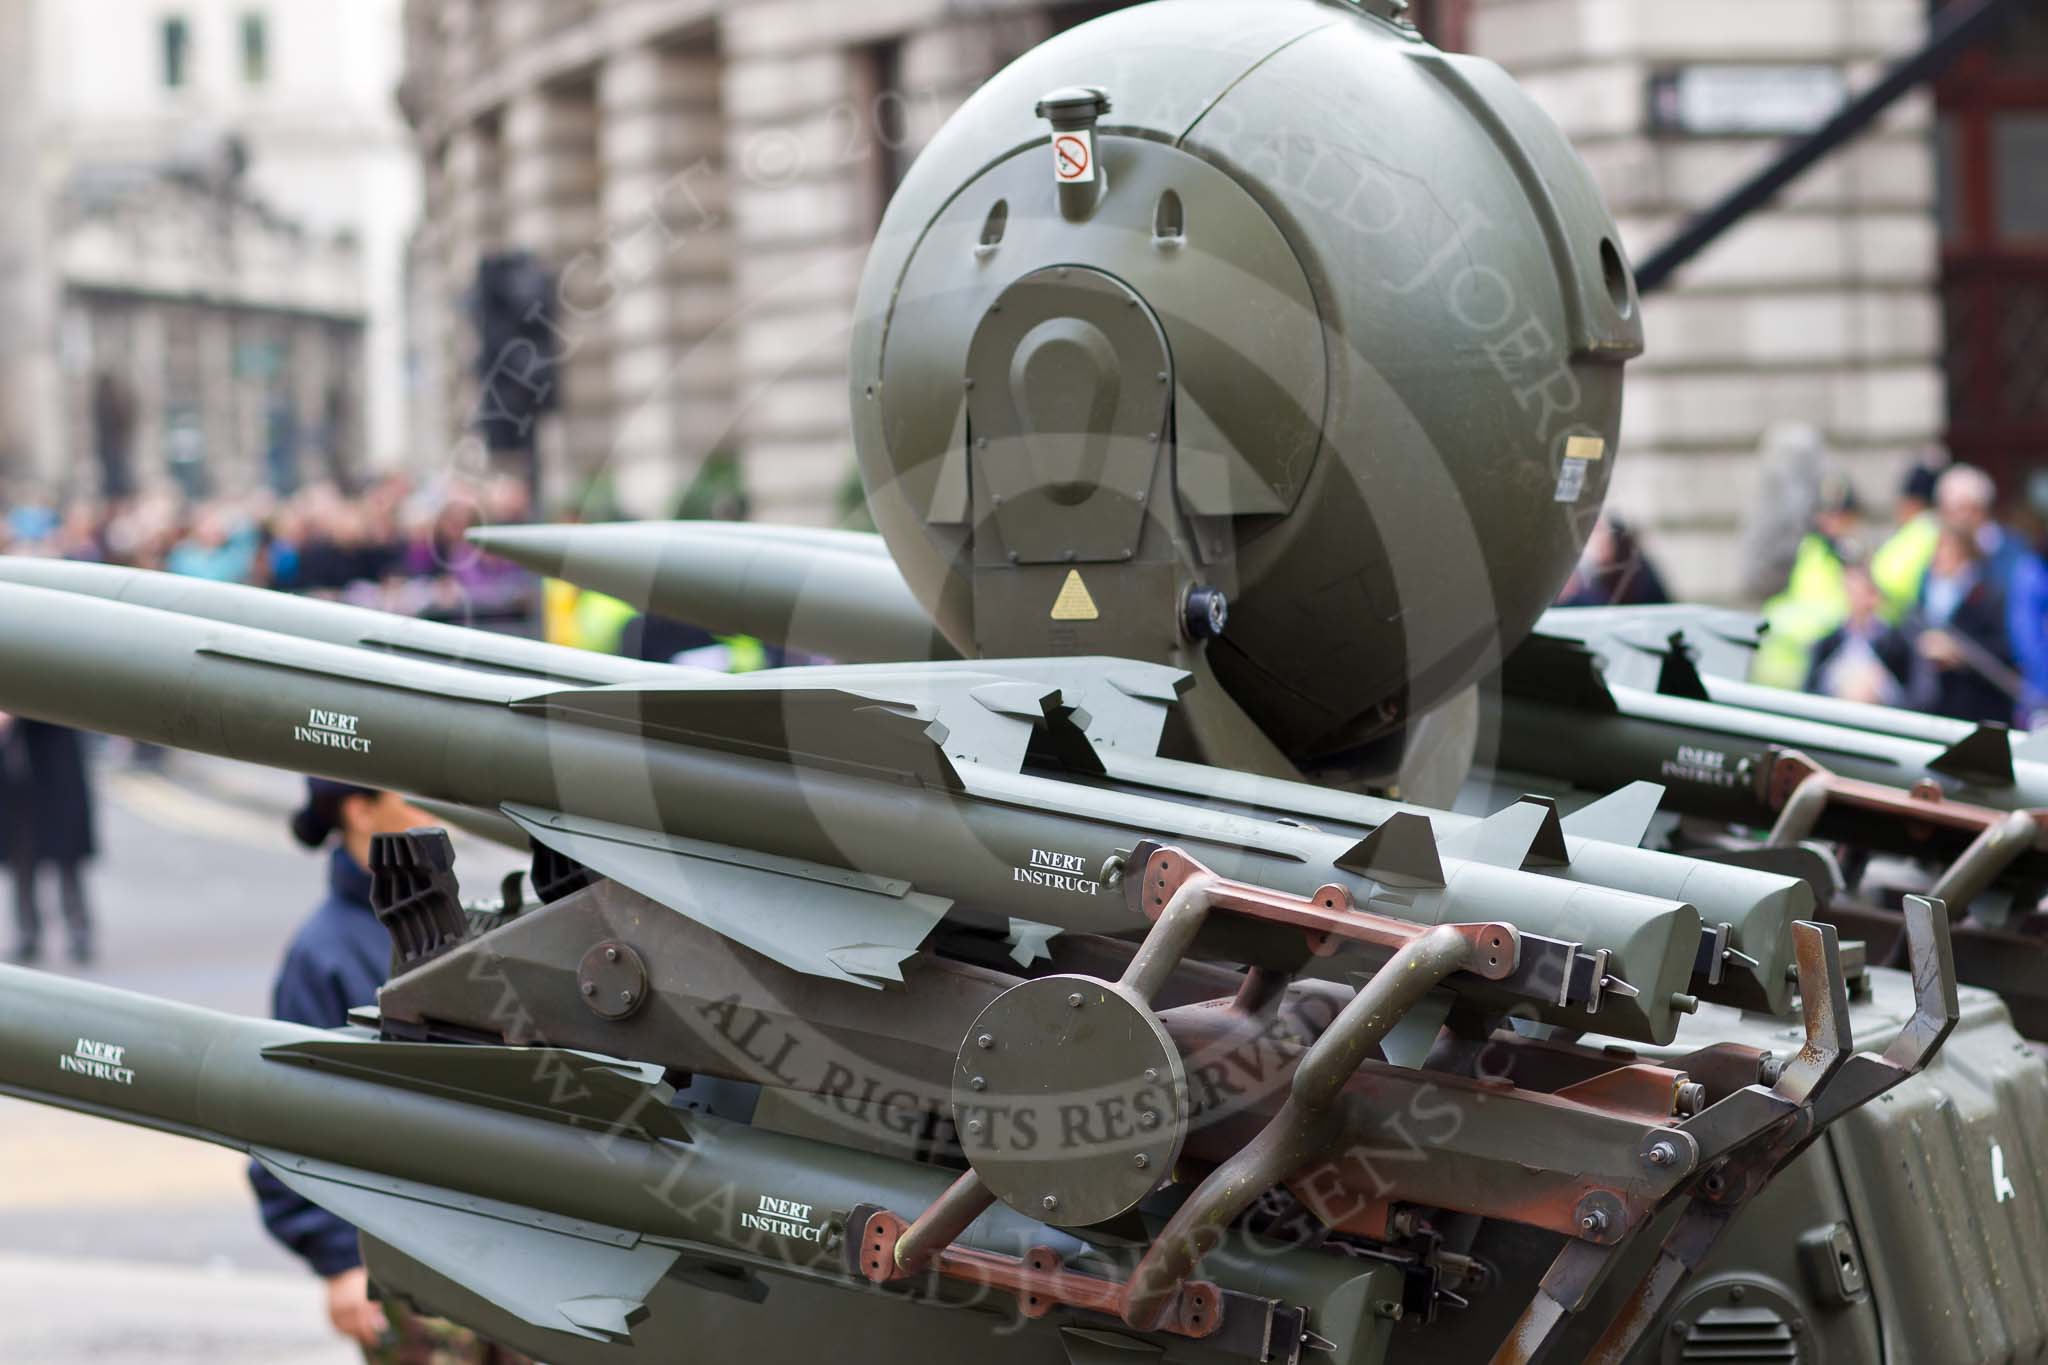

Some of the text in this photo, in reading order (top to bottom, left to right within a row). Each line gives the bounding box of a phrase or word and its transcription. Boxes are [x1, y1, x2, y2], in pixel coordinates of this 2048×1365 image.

[308, 708, 359, 735] INERT
[294, 726, 372, 753] INSTRUCT
[1030, 848, 1086, 875] INERT
[1013, 867, 1100, 896] INSTRUCT
[75, 1037, 125, 1065] INERT
[60, 1054, 135, 1085] INSTRUCT
[757, 1194, 813, 1223] INERT
[741, 1212, 821, 1243] INSTRUCT
